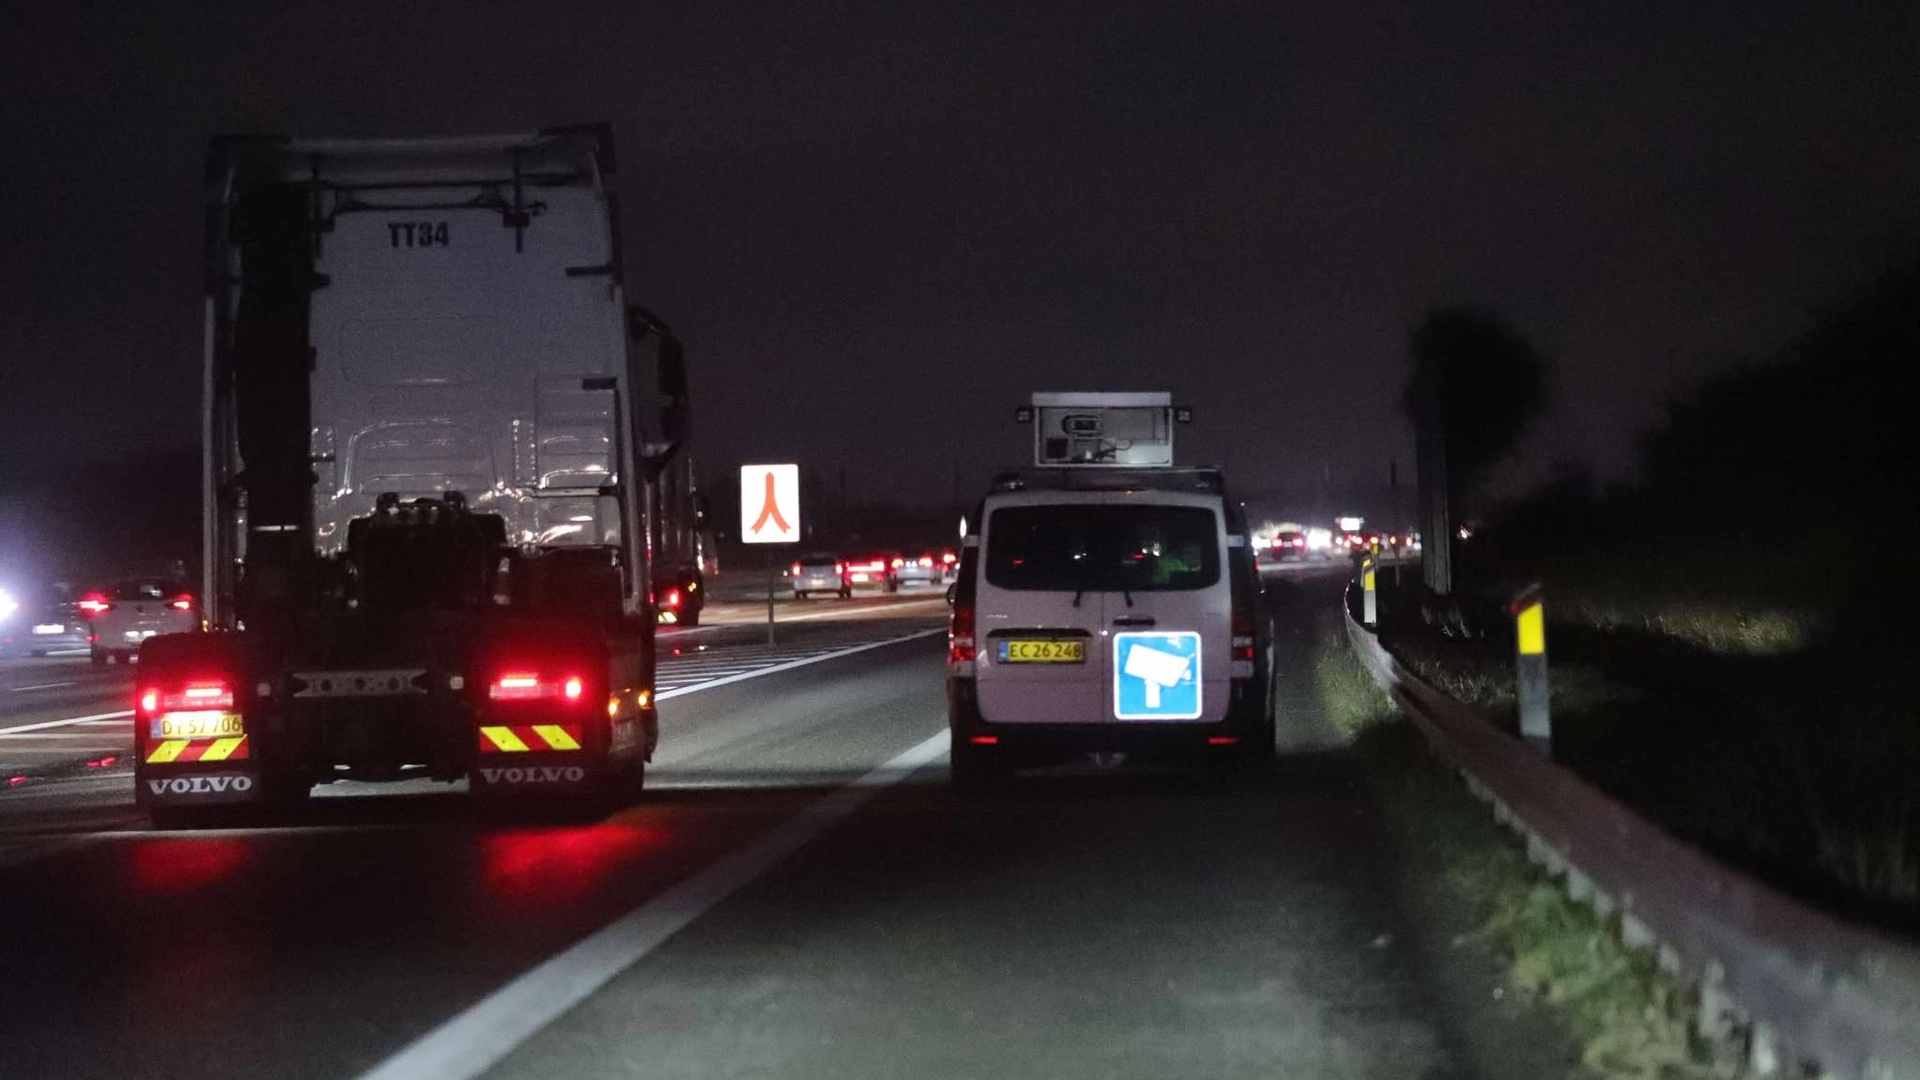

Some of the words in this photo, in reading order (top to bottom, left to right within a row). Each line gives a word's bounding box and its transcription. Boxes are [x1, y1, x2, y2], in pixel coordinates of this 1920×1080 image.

[388, 222, 449, 247] TT34
[480, 766, 584, 784] VOLVO
[147, 776, 252, 795] VOLVO
